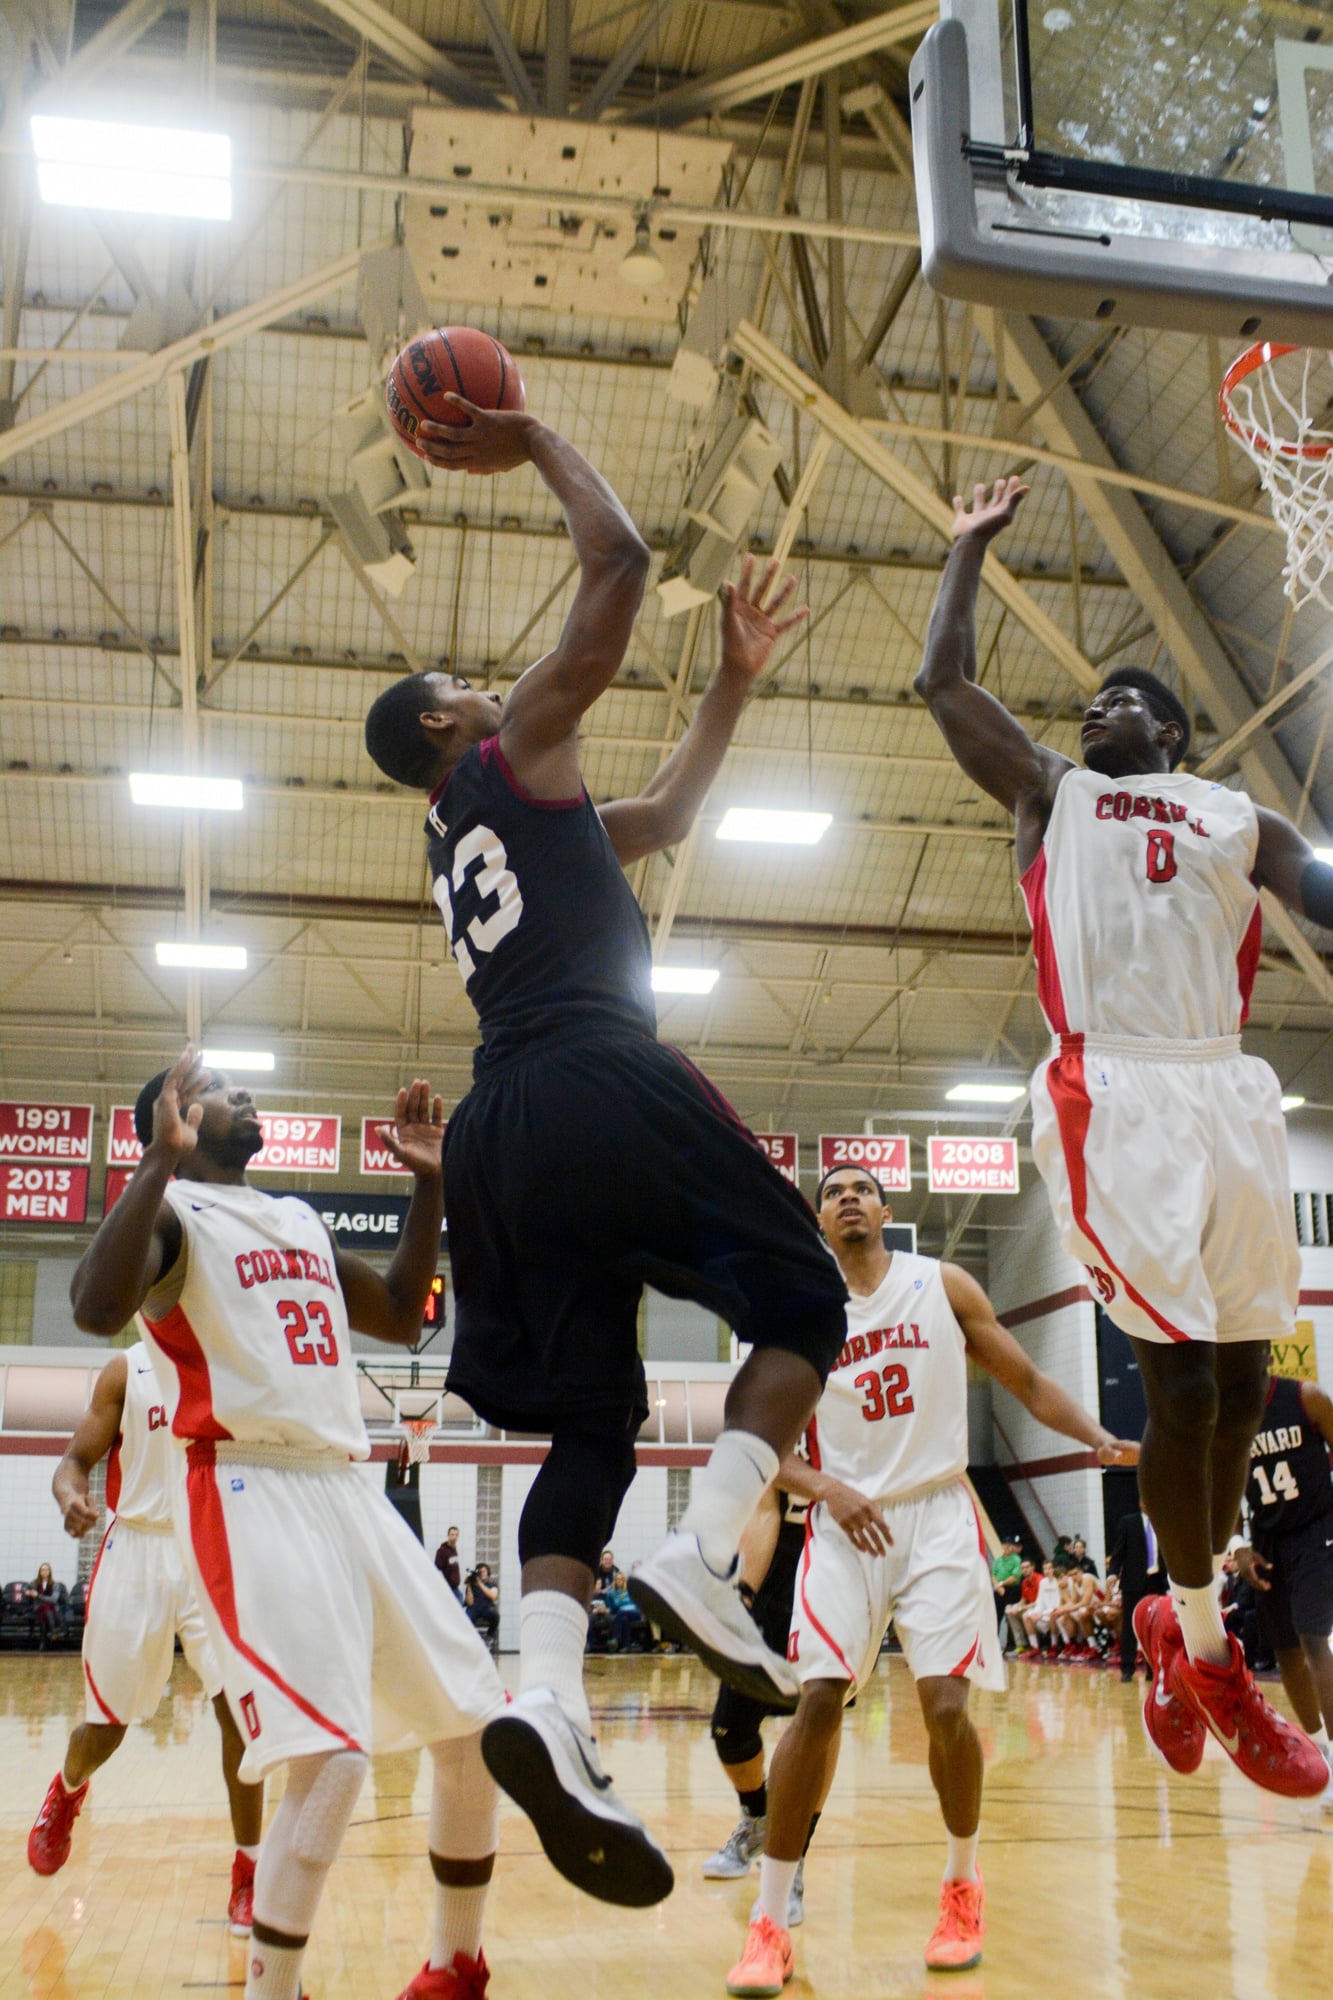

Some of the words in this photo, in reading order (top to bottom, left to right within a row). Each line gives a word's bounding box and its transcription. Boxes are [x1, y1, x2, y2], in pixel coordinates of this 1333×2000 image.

[15, 1107, 71, 1130] 1991
[262, 1119, 322, 1142] 1997
[0, 1134, 88, 1155] WOMEN
[833, 1140, 896, 1162] 2007
[942, 1142, 1005, 1165] 2008
[6, 1168, 72, 1192] 2013
[933, 1167, 1014, 1187] WOMEN
[6, 1194, 68, 1217] MEN
[321, 1211, 399, 1232] EAGUE
[276, 1300, 339, 1366] 23
[829, 1323, 930, 1373] ORNELL
[1273, 1344, 1310, 1366] VY
[854, 1363, 914, 1422] 32
[1252, 1461, 1299, 1505] 14
